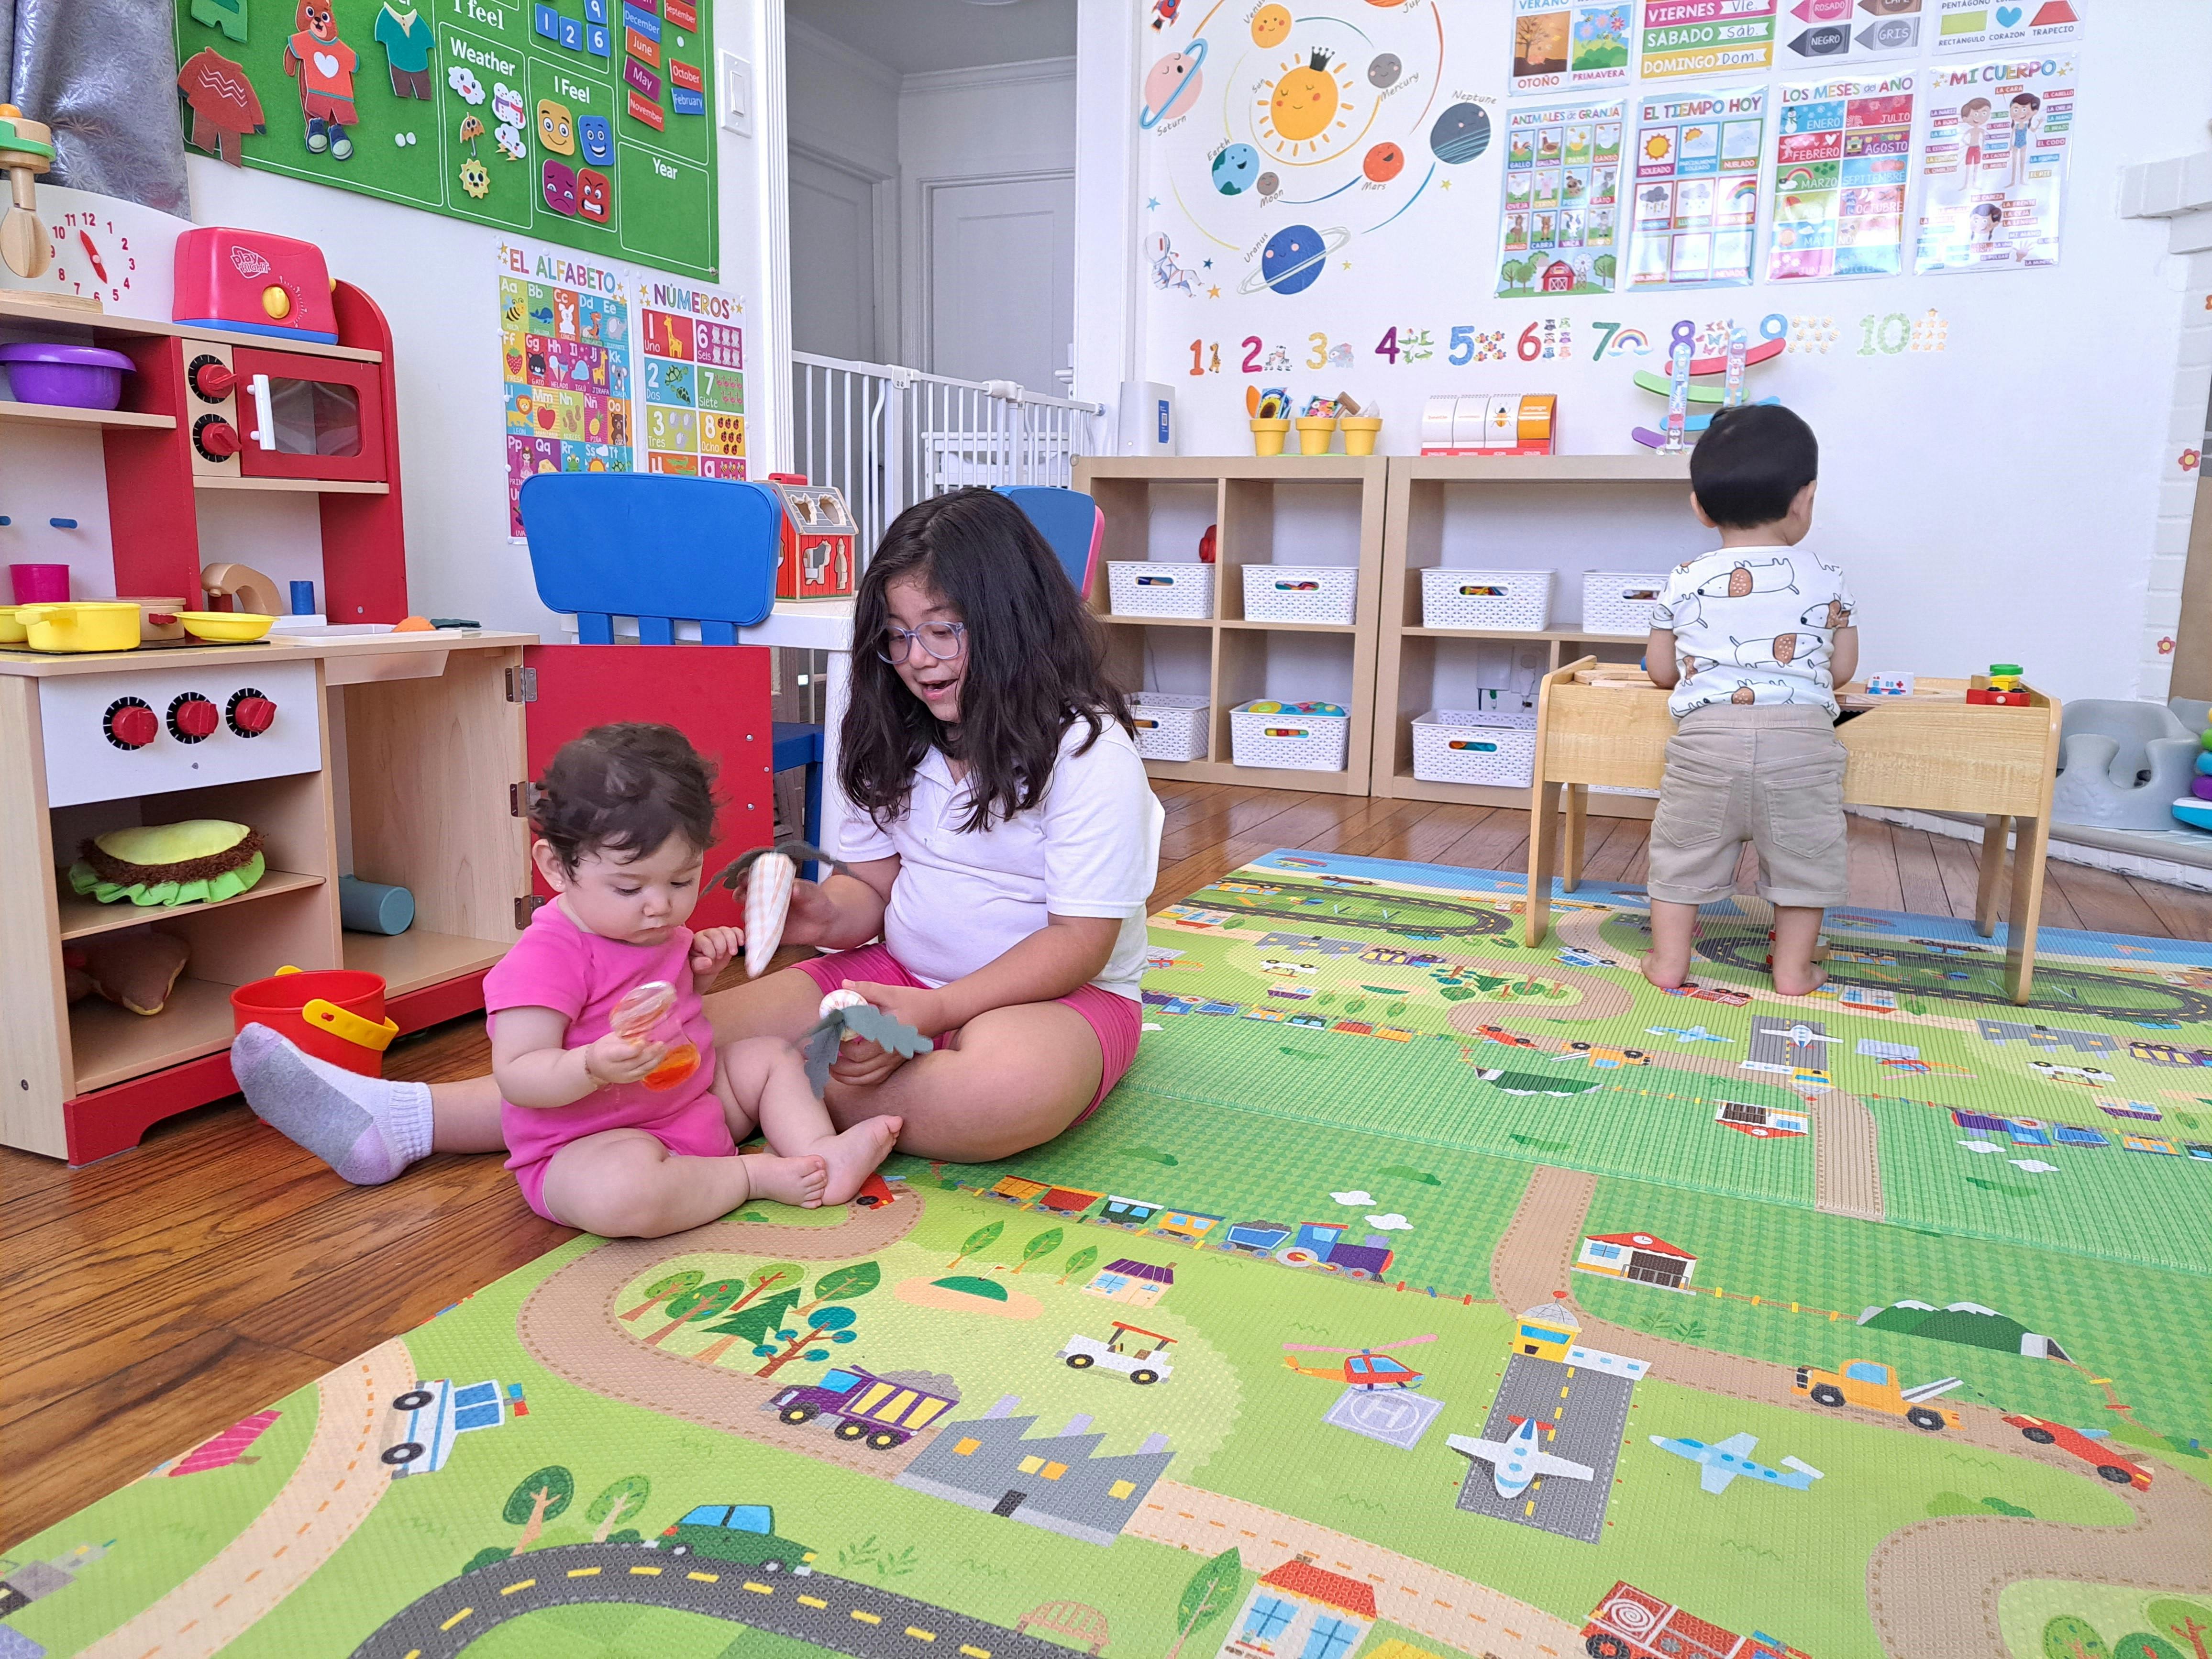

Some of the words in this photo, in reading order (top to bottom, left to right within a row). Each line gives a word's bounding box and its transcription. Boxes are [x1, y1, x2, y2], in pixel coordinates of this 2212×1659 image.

[591, 0, 601, 18] 9
[666, 2, 696, 24] September
[1648, 2, 1715, 22] VIERNES
[1814, 2, 1845, 11] ROSADO
[467, 0, 504, 30] feel
[544, 13, 549, 31] 1
[625, 11, 660, 34] December
[566, 25, 575, 44] 2
[1648, 27, 1714, 47] SÁBADO
[1879, 28, 1910, 40] GRIS
[2033, 25, 2075, 36] TRAPECIO
[594, 31, 604, 48] 6
[633, 36, 653, 56] June
[1811, 34, 1840, 46] NEGRO
[450, 36, 516, 76] Weather
[1644, 55, 1716, 74] DOMINGO
[1722, 52, 1759, 64] Dom.
[633, 67, 653, 91] May
[673, 66, 700, 84] October
[1572, 69, 1625, 81] PRIMAVERA
[1950, 67, 1979, 87] MI
[1982, 59, 2057, 83] CUERPO
[1252, 78, 1266, 93] Sun
[1381, 72, 1420, 101] Mercury
[1517, 75, 1559, 89] OTOÑO
[554, 76, 559, 93] I
[562, 78, 590, 104] Feel
[1452, 90, 1498, 105] Neptune
[1783, 88, 1810, 103] LOS
[1814, 82, 1860, 100] MESES
[675, 94, 703, 108] February
[1644, 106, 1659, 120] EL
[1664, 100, 1725, 118] TIEMPO
[1729, 96, 1762, 112] HOY
[630, 100, 663, 123] November
[1512, 112, 1565, 125] ANIMALES
[1579, 107, 1620, 120] GRANJA
[1880, 112, 1910, 124] JULIO
[1156, 114, 1187, 137] Saturn
[1807, 117, 1841, 130] ENERO
[1206, 138, 1231, 162] Earth
[1793, 147, 1840, 161] FEBRERO
[1866, 142, 1908, 155] AGOSTO
[653, 157, 678, 180] Year
[1724, 160, 1755, 168] NUBLADO
[1801, 177, 1838, 189] MARZO
[1843, 172, 1906, 185] SEPTIEMBRE
[1361, 182, 1387, 191] Mars
[1259, 188, 1284, 209] Moon
[1856, 201, 1902, 214] OCTUBRE
[65, 213, 77, 227] 11
[82, 212, 96, 227] 12
[52, 226, 66, 240] 10
[107, 221, 113, 234] 1
[122, 237, 129, 251] 2
[1243, 232, 1270, 264] Uranus
[129, 258, 135, 271] 3
[230, 250, 257, 269] play
[58, 268, 65, 281] 8
[240, 262, 269, 274] RIGHT
[510, 248, 530, 274] EL
[536, 255, 616, 293] ALFABETO
[74, 282, 80, 296] 7
[123, 277, 130, 290] 4
[501, 278, 518, 293] Aa
[528, 283, 543, 299] Bb
[93, 291, 101, 302] 6
[112, 288, 119, 301] 5
[554, 288, 568, 303] Cc
[579, 295, 594, 309] Dd
[654, 283, 730, 320] NÚMEROS
[603, 300, 617, 314] Ee
[648, 313, 654, 339] 1
[503, 333, 516, 345] Ff
[526, 334, 540, 351] Gg
[697, 324, 708, 348] 6
[547, 338, 561, 354] Hh
[570, 343, 578, 356] Ii
[644, 340, 661, 353] Uno
[1189, 338, 1205, 376] 1
[1241, 335, 1263, 373] 2
[1305, 332, 1329, 370] 3
[1374, 326, 1401, 365] 4
[1448, 325, 1475, 366] 5
[1517, 321, 1542, 362] 6
[1592, 321, 1622, 362] 7
[1669, 320, 1696, 359] 8
[1857, 312, 1912, 357] 10
[590, 347, 597, 362] Jj
[609, 350, 621, 364] Kk
[507, 375, 524, 383] FRESA
[531, 378, 544, 386] GATO
[648, 362, 659, 388] 2
[551, 381, 569, 389] HELADO
[592, 387, 610, 395] JIRAFA
[704, 371, 714, 396] 7
[532, 388, 553, 403] Mm
[559, 392, 573, 406] Nn
[585, 393, 597, 409] Ññ
[646, 389, 661, 401] Dos
[608, 400, 621, 412] Oo
[653, 410, 665, 436] 3
[705, 415, 716, 439] 8
[508, 436, 522, 452] Pp
[535, 438, 551, 455] Qq
[562, 442, 574, 454] Rr
[648, 436, 666, 448] Tres
[701, 441, 719, 452] Ocho
[585, 444, 596, 456] Ss
[609, 447, 619, 458] Tt
